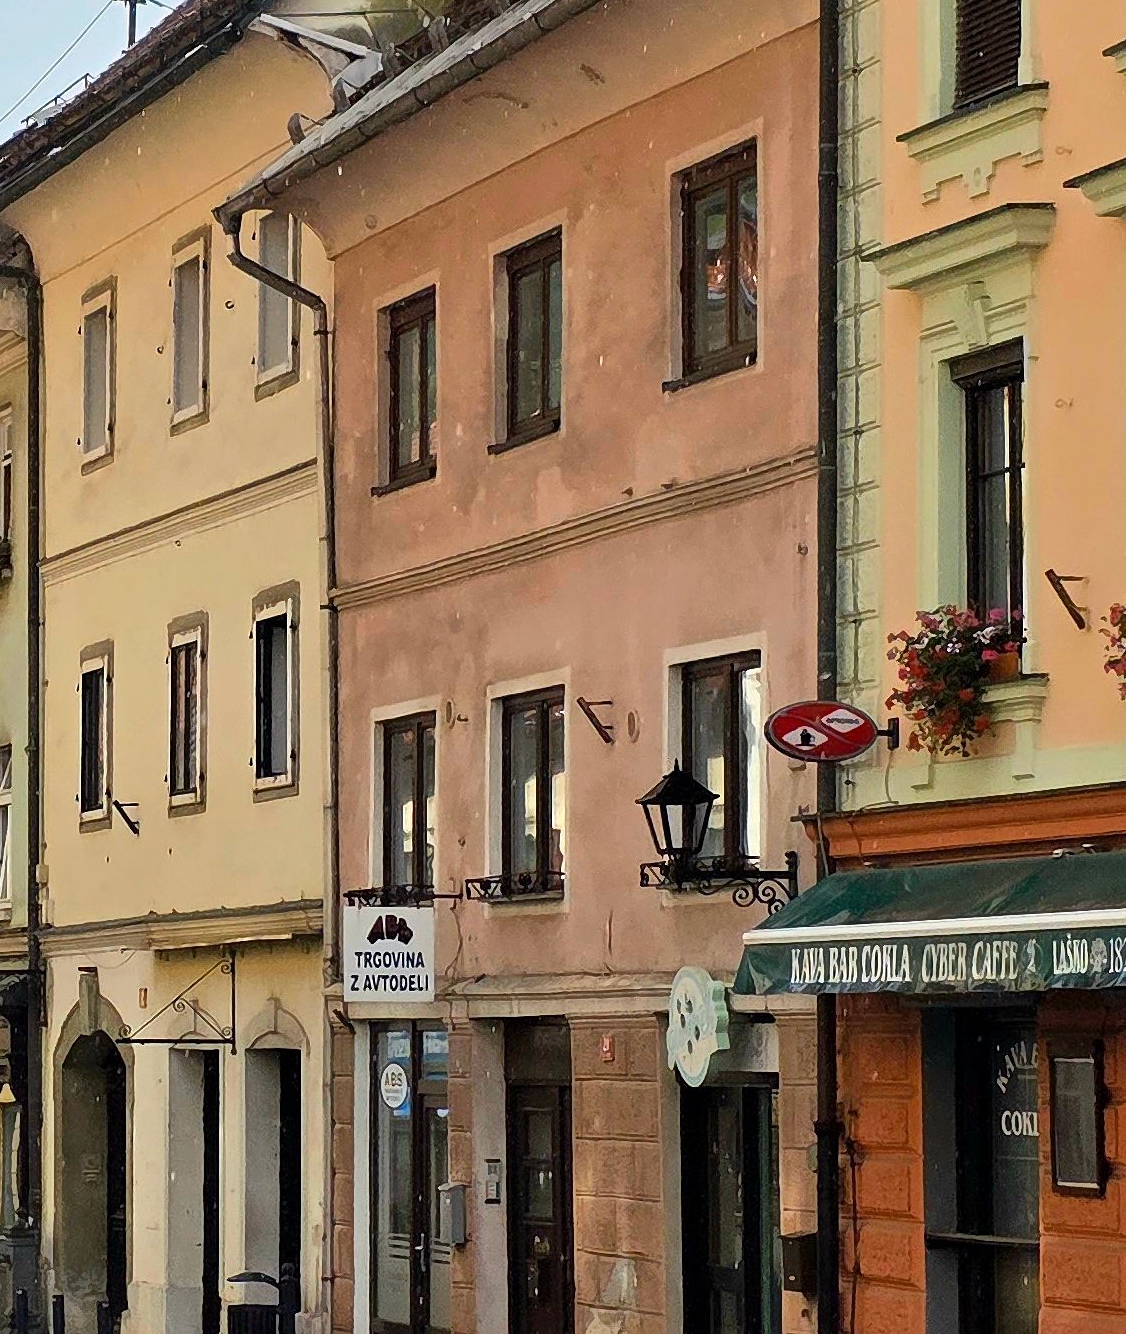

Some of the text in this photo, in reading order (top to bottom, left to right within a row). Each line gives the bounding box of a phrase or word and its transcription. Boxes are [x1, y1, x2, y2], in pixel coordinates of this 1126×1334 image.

[354, 951, 425, 968] TRGOVINA
[790, 944, 911, 984] KAVA BAR COKLA
[921, 939, 1019, 982] CYBER CAFFE
[1052, 932, 1089, 975] LAŠKO
[350, 973, 429, 992] Z AVTODELI
[1000, 1109, 1040, 1137] COKL
